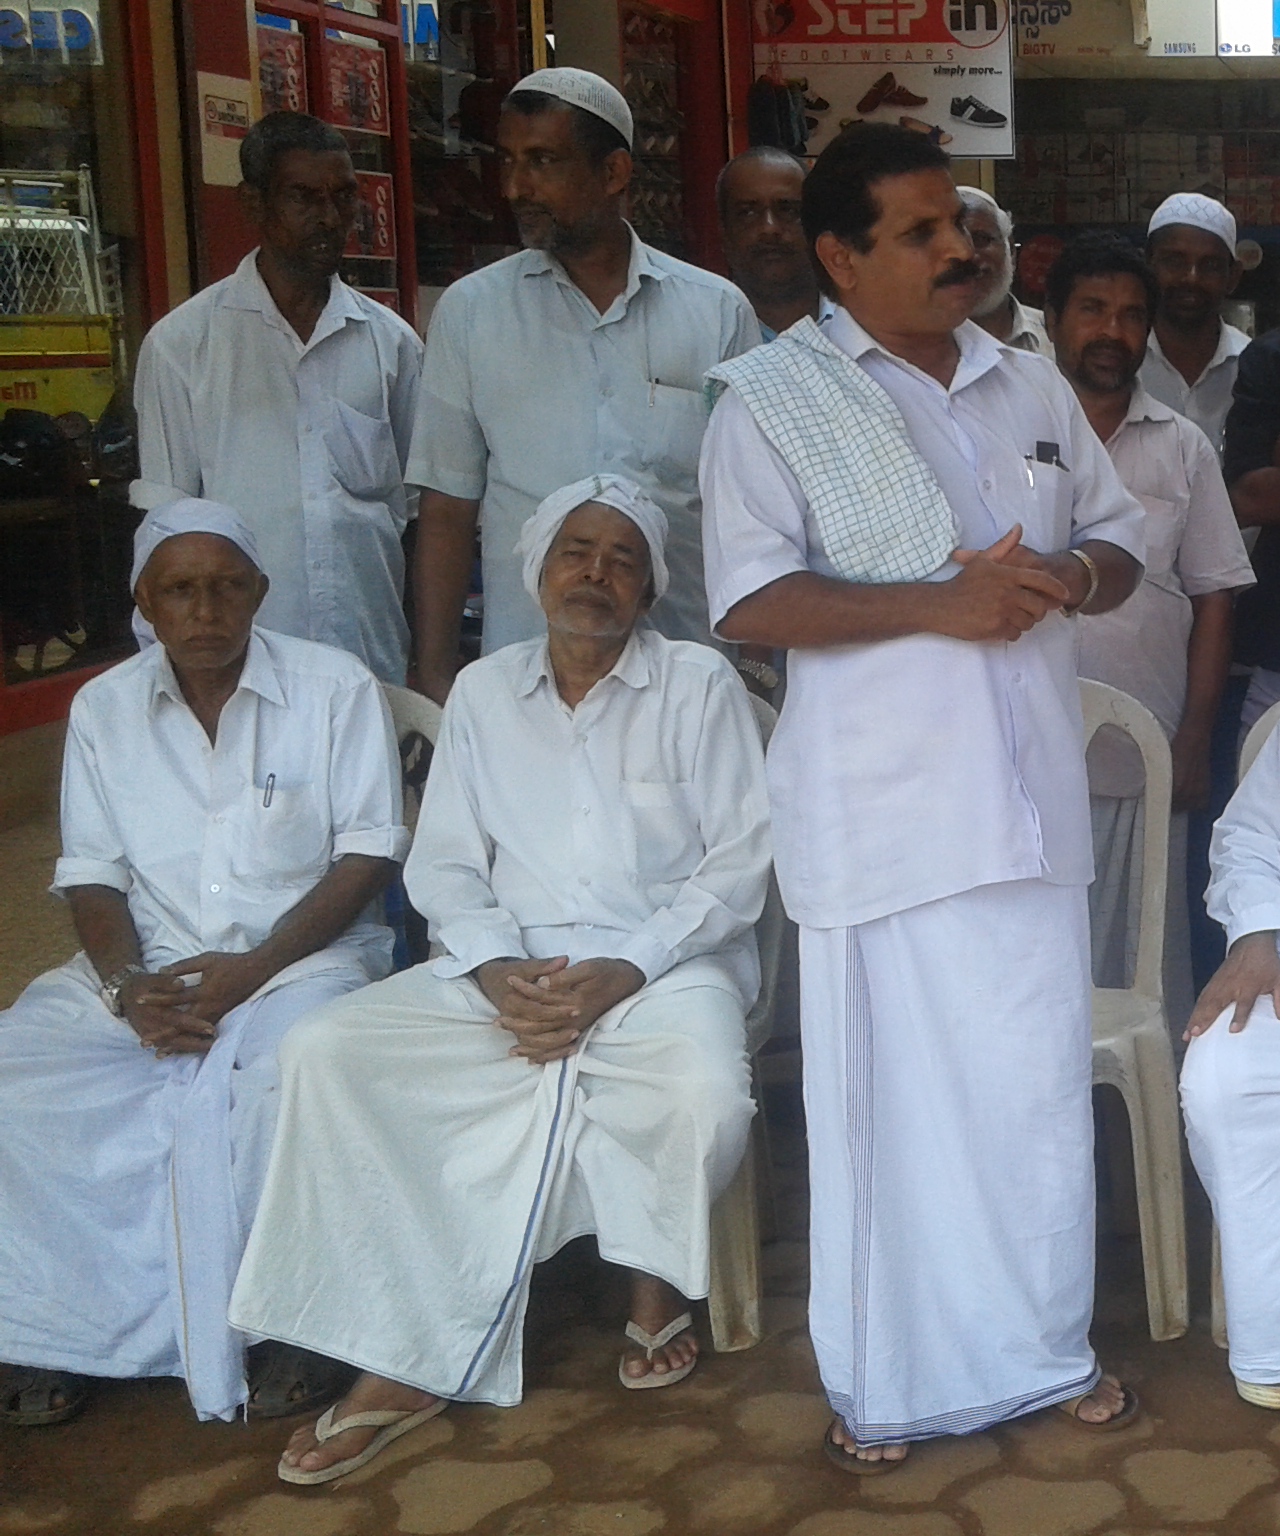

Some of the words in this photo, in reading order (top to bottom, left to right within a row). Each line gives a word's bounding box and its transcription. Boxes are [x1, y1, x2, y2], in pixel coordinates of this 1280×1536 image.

[807, 0, 927, 35] STEP
[950, 0, 998, 31] in
[1163, 43, 1197, 54] SAMSUNG
[1234, 44, 1251, 53] LG
[780, 49, 955, 61] FOOTWEARS
[933, 65, 966, 77] simply
